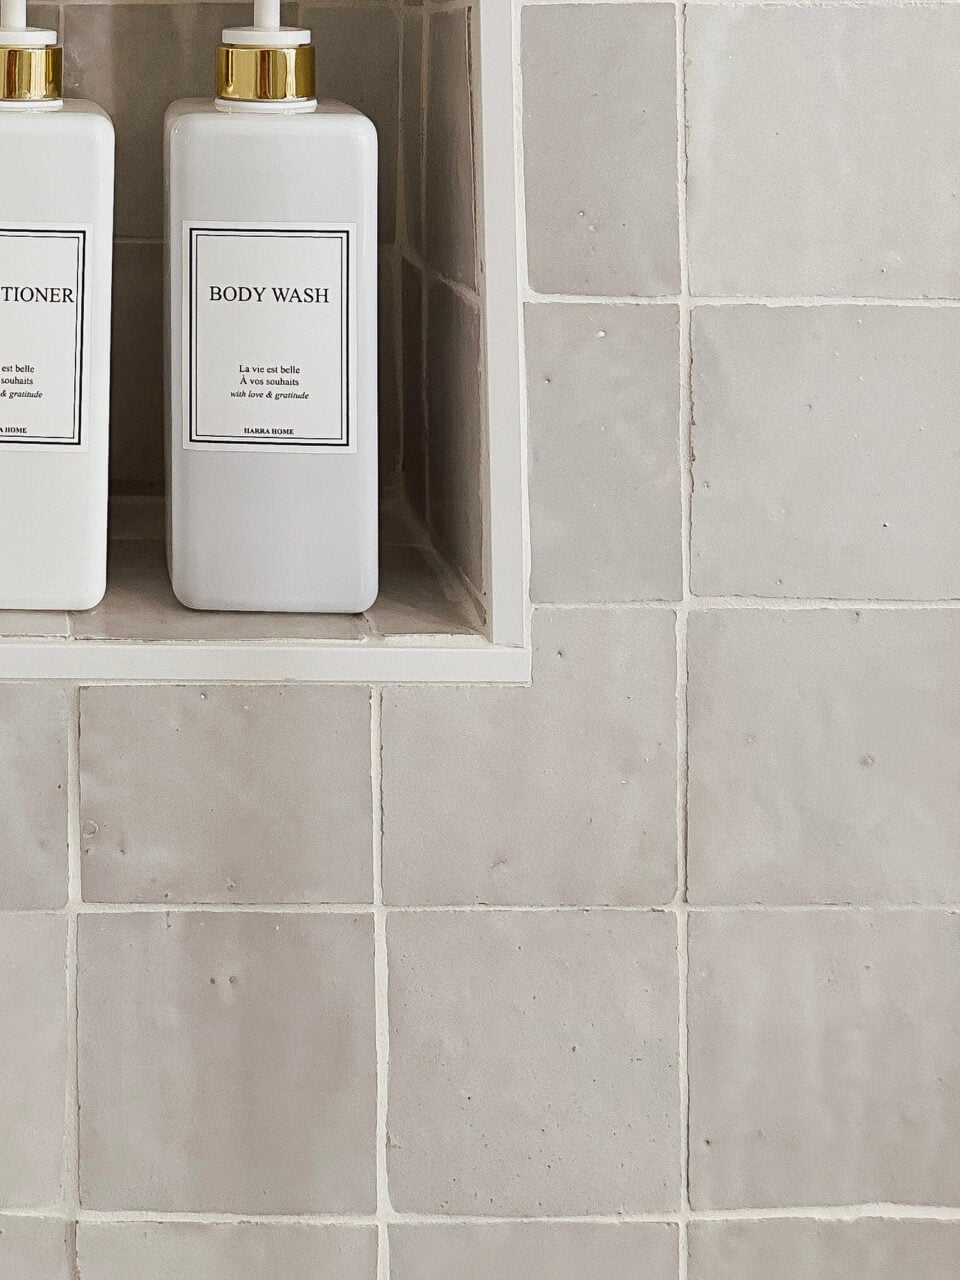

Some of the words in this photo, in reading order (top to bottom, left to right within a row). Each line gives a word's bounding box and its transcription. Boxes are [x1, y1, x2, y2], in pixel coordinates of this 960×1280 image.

[209, 285, 267, 302] BODY
[271, 287, 330, 304] WASH
[15, 364, 35, 373] belle
[239, 364, 250, 373] La
[252, 365, 265, 373] vie
[280, 365, 301, 374] belle
[0, 376, 34, 385] souhaits
[239, 375, 247, 385] À
[265, 377, 300, 386] souhaits
[0, 389, 7, 397] &
[8, 389, 43, 399] gratitude
[230, 390, 246, 398] with
[248, 390, 264, 399] love
[274, 391, 310, 400] gratitude
[4, 426, 28, 434] HOME
[243, 427, 270, 435] HARRA
